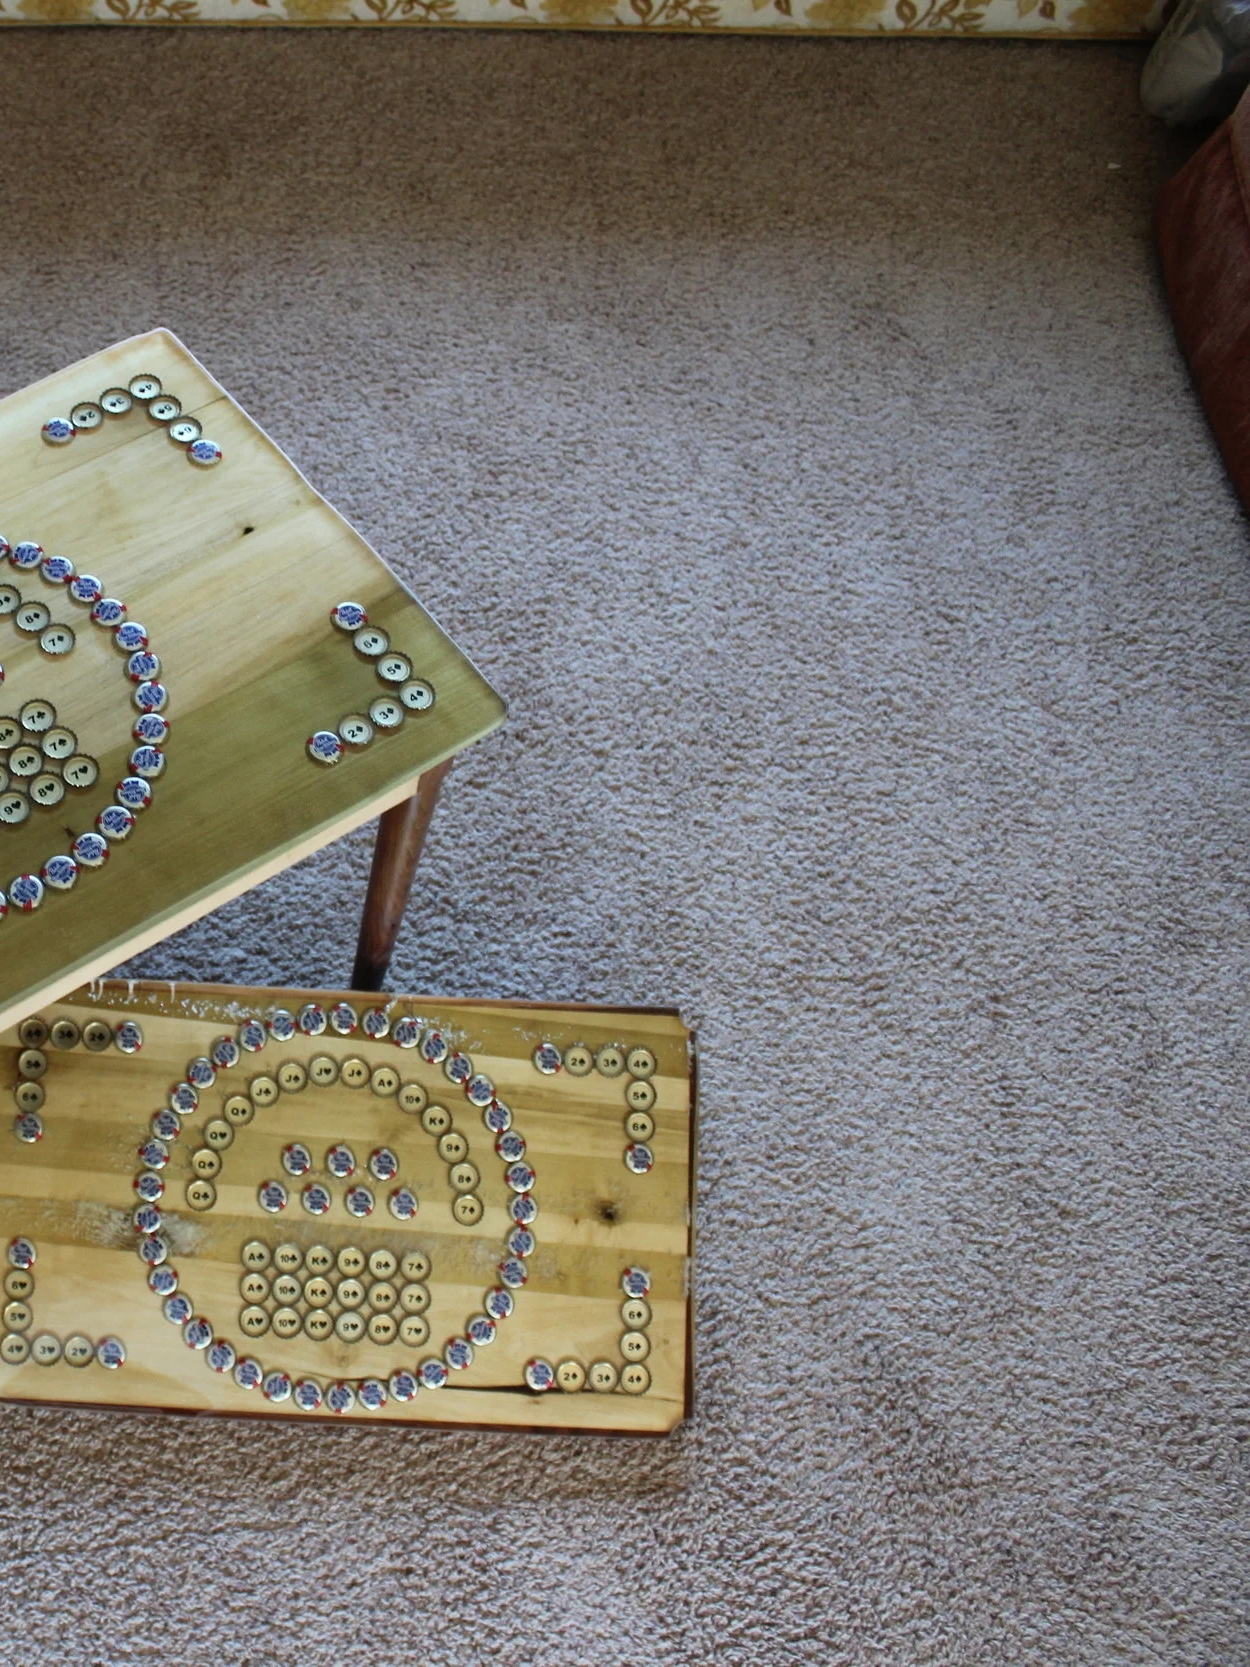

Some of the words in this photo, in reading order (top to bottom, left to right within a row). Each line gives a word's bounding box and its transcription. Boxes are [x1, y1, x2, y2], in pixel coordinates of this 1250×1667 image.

[25, 615, 34, 624] 8
[48, 638, 56, 647] 7
[363, 640, 372, 648] 6
[387, 666, 396, 675] 5
[409, 693, 418, 702] 4
[379, 711, 388, 719] 3
[27, 715, 36, 724] 7
[348, 730, 358, 738] 2
[49, 742, 58, 751] 7
[18, 759, 27, 768] 8
[71, 770, 80, 780] 7
[38, 787, 47, 797] 8
[4, 805, 13, 814] 9
[571, 1058, 578, 1066] 2
[634, 1060, 640, 1068] 4
[316, 1068, 322, 1076] J
[349, 1069, 355, 1077] J
[377, 1079, 385, 1087] A
[256, 1088, 262, 1096] J
[633, 1092, 639, 1100] 5
[405, 1096, 415, 1104] 10
[231, 1107, 239, 1115] Q
[633, 1123, 639, 1131] 6
[446, 1144, 452, 1152] 9
[198, 1161, 206, 1169] Q
[458, 1175, 464, 1183] 8
[193, 1192, 201, 1200] Q
[461, 1206, 468, 1214] 7
[248, 1253, 257, 1261] A
[312, 1257, 320, 1265] K
[344, 1258, 351, 1266] 9
[376, 1261, 383, 1269] 8
[408, 1263, 415, 1271] 7
[12, 1281, 19, 1289] 6
[247, 1284, 255, 1292] A
[279, 1286, 288, 1294] 10
[376, 1294, 383, 1302] 8
[408, 1295, 415, 1303] 7
[10, 1313, 17, 1321] 5
[629, 1311, 635, 1319] 6
[247, 1317, 255, 1325] A
[279, 1319, 288, 1327] 10
[310, 1321, 319, 1329] K
[343, 1323, 350, 1331] 9
[374, 1325, 382, 1333] 8
[628, 1343, 634, 1351] 5
[72, 1348, 78, 1356] 2
[563, 1373, 570, 1381] 2
[597, 1375, 603, 1383] 3
[628, 1375, 635, 1383] 4
